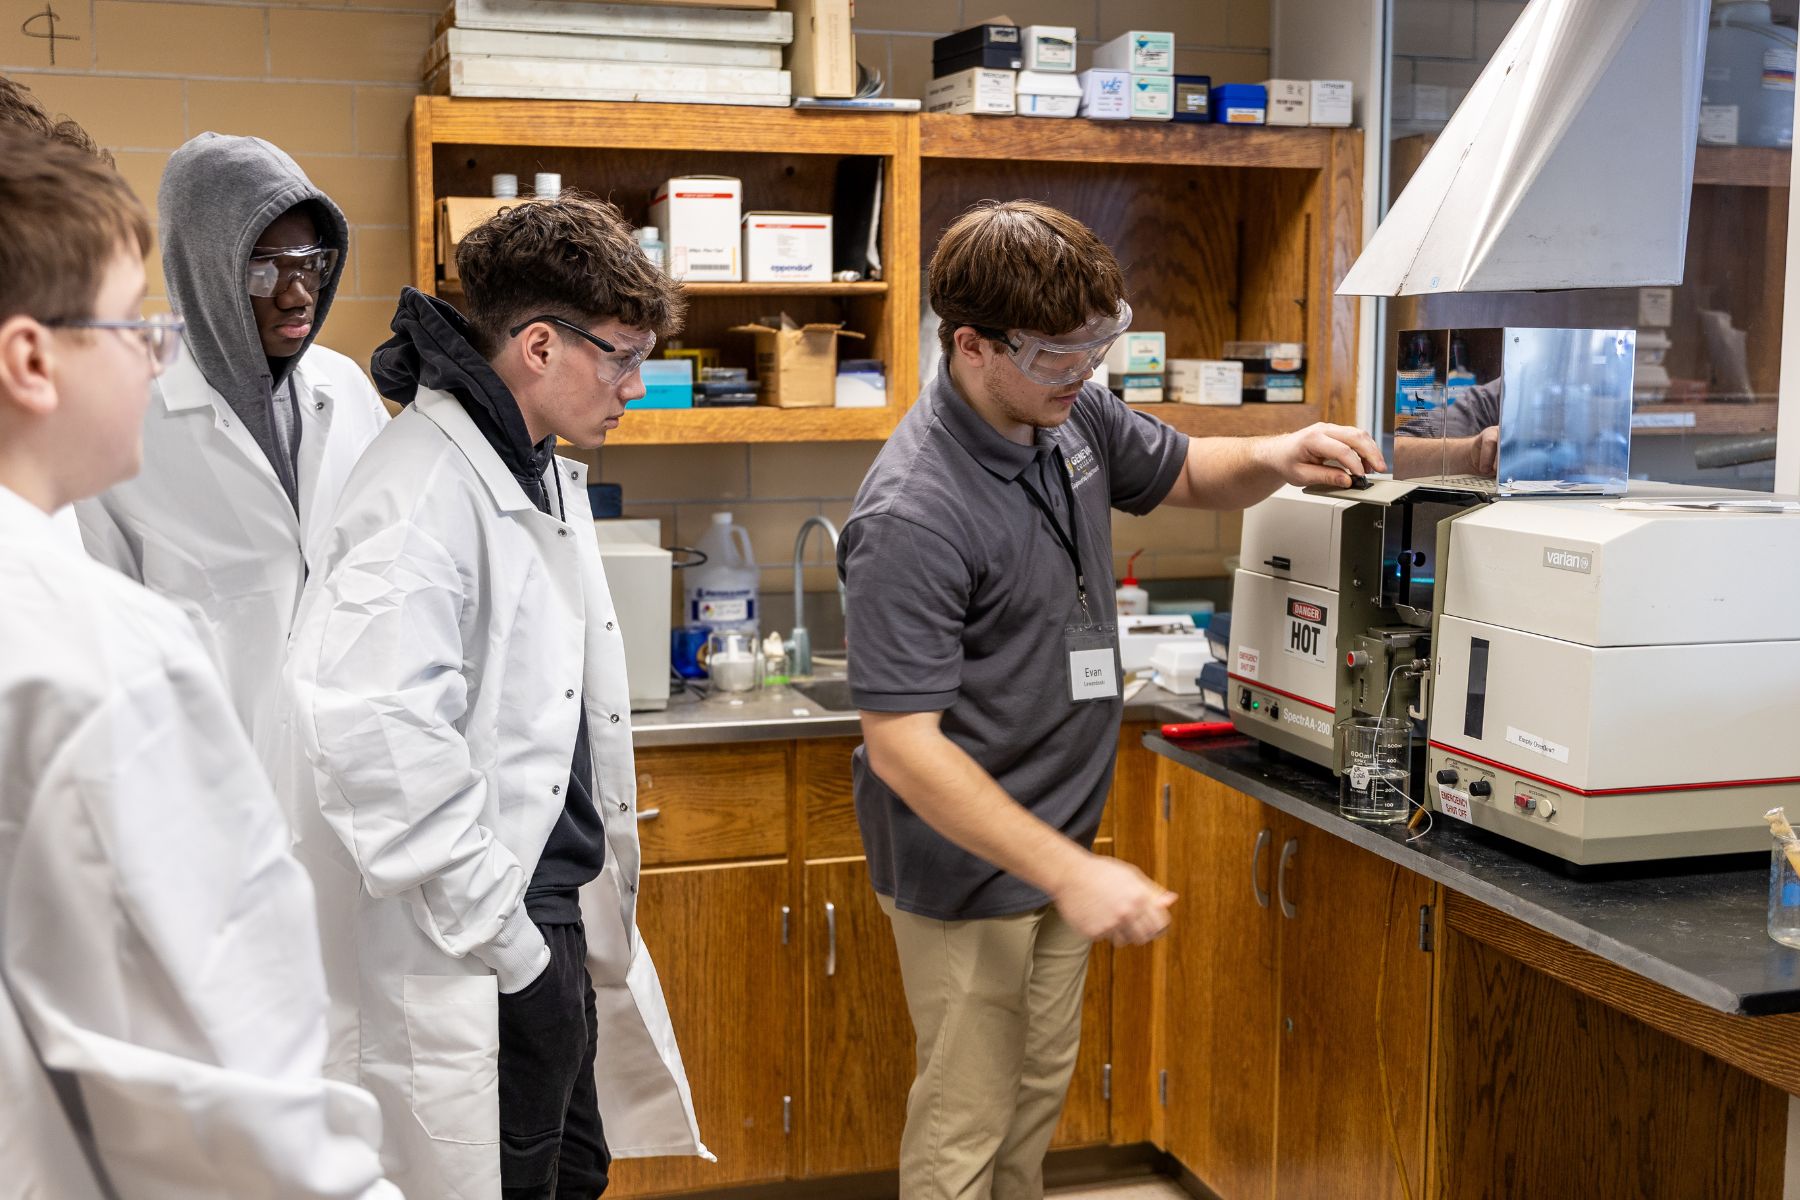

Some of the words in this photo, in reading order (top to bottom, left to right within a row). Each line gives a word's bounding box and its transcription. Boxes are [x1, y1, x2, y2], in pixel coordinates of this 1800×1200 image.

[770, 264, 813, 273] eppendorf
[1071, 446, 1092, 465] GENEVA
[1546, 551, 1580, 569] varian
[1294, 603, 1320, 620] DANGER
[1291, 620, 1320, 656] HOT
[1085, 668, 1102, 677] Evan
[1283, 708, 1330, 735] SpectrAA-200
[1518, 735, 1533, 747] Empty
[1441, 790, 1468, 808] EMERGENCY
[1445, 803, 1458, 816] SHUT
[1459, 807, 1468, 819] OFF
